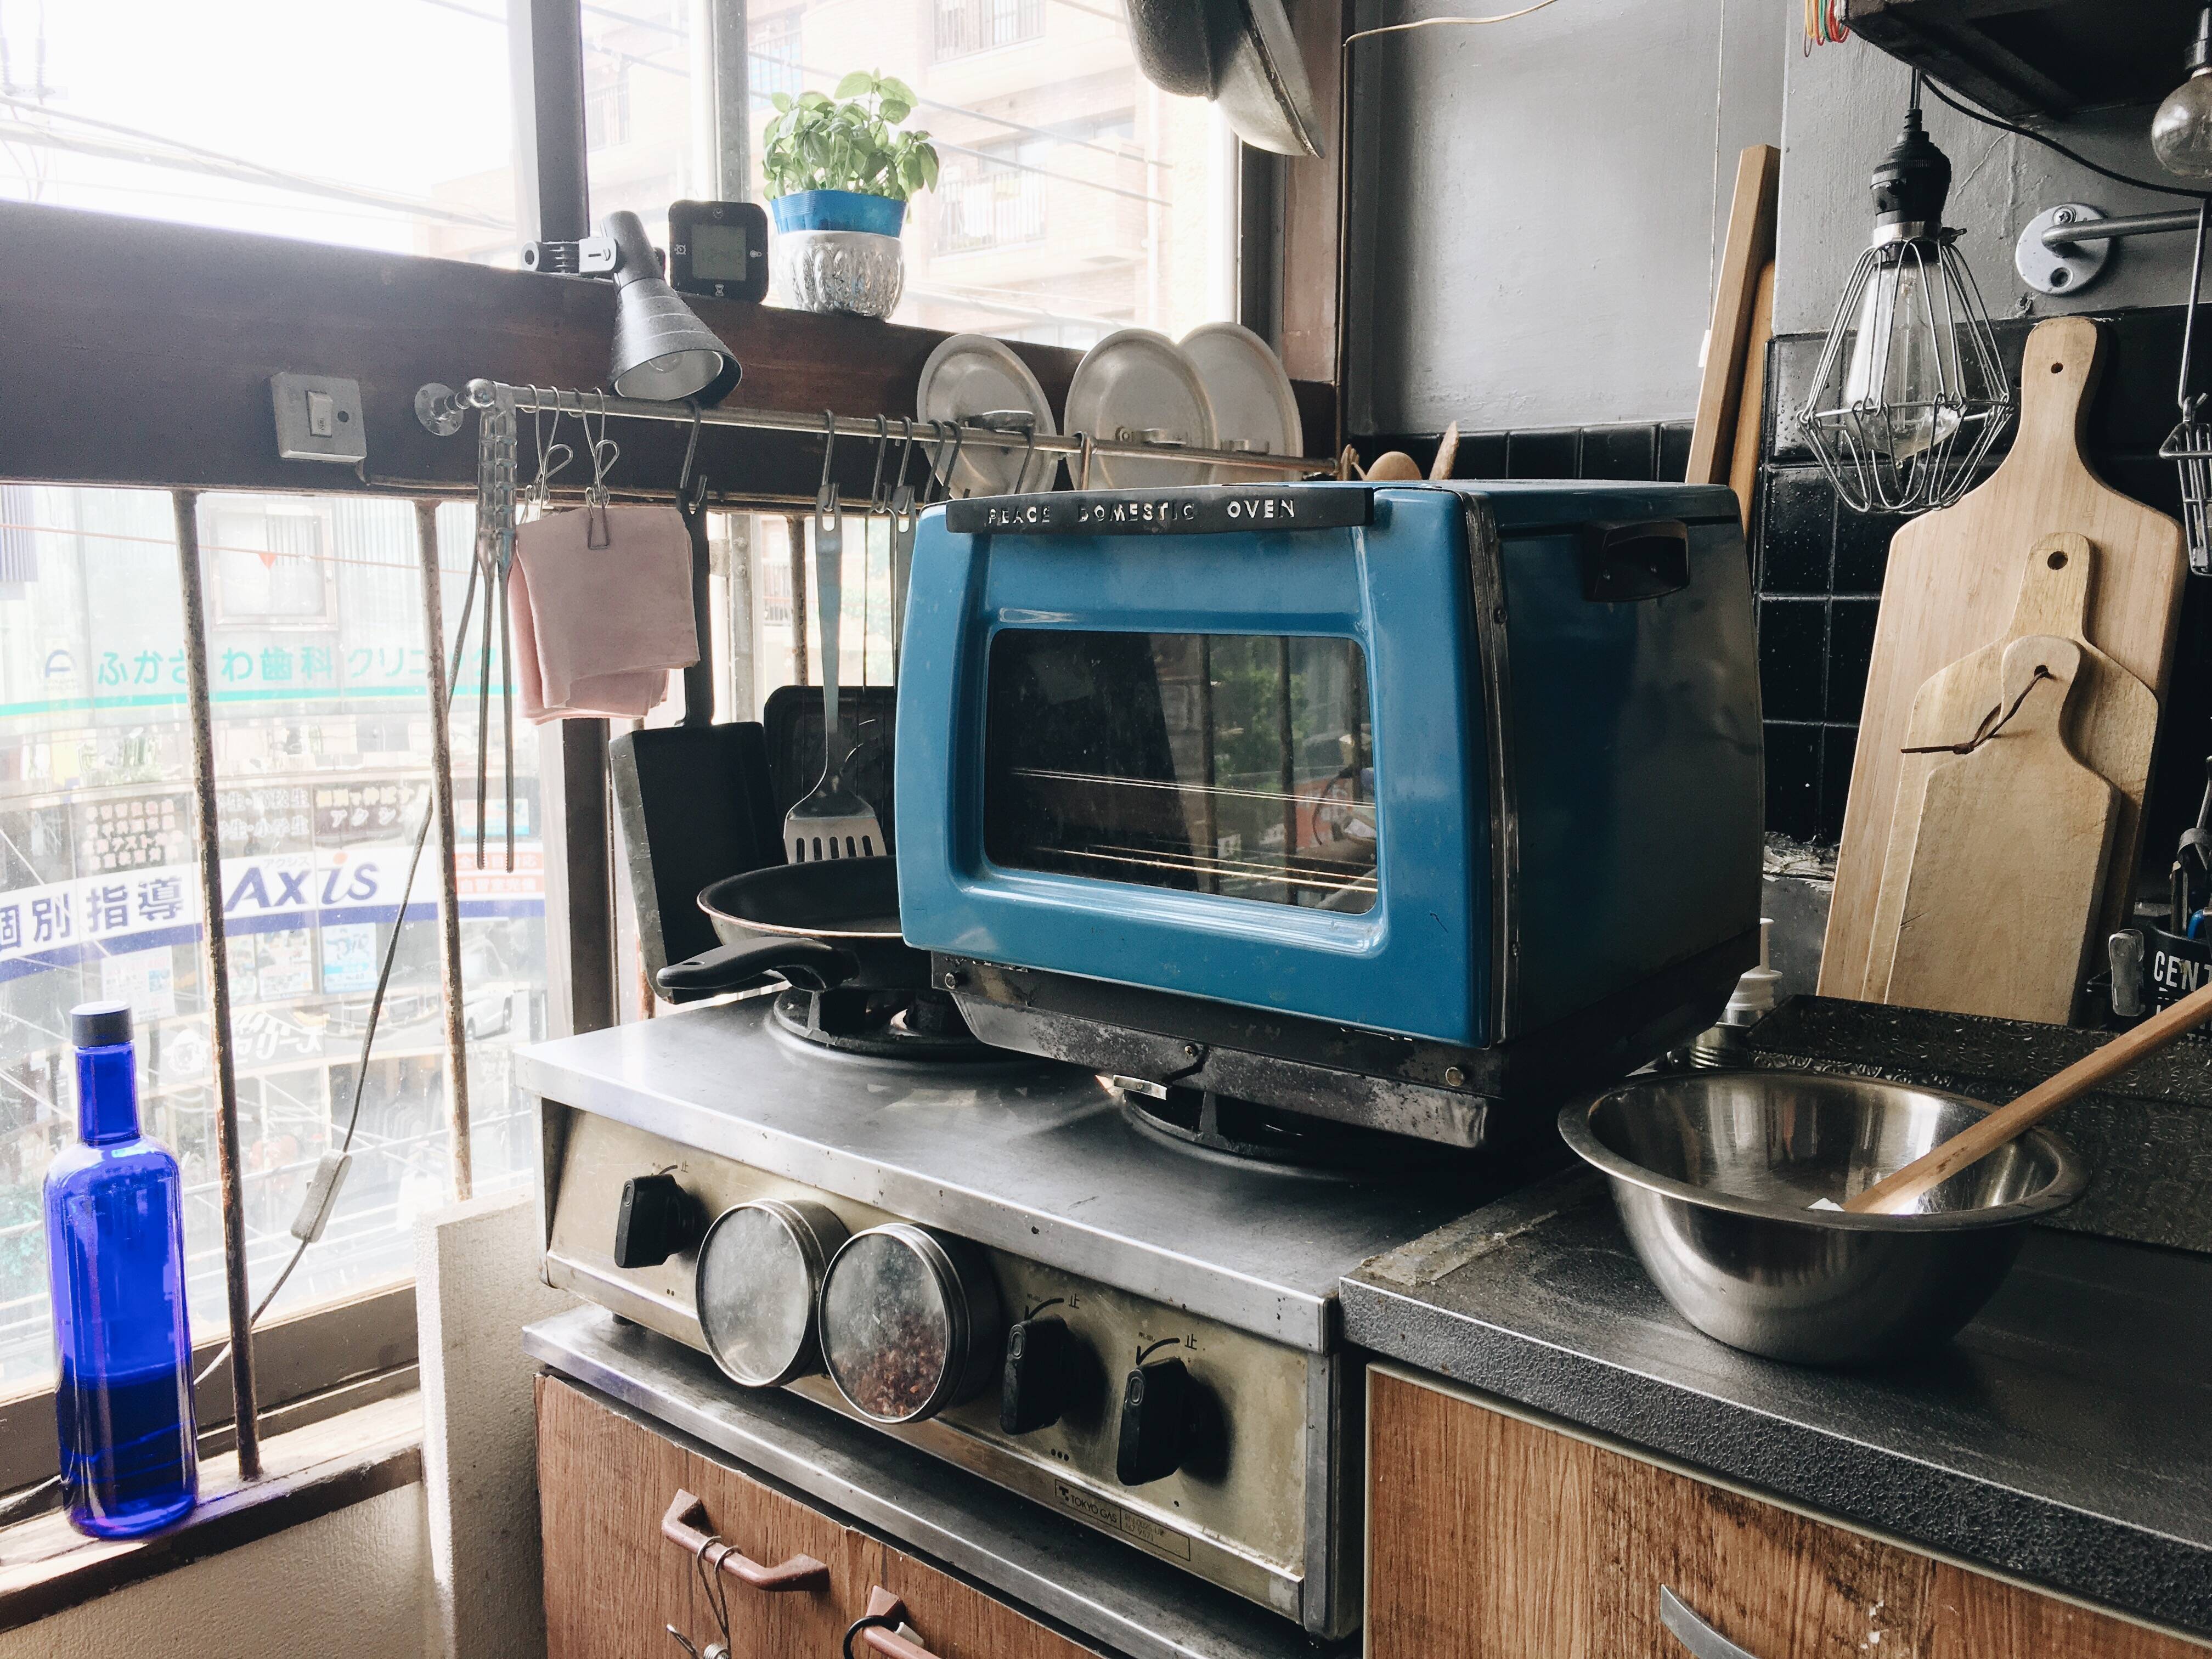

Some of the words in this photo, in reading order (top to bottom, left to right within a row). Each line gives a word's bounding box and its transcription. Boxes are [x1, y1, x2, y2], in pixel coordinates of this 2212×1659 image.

[988, 506, 1050, 524] PEACE
[1078, 501, 1194, 522] DOMESTIC
[1227, 498, 1295, 519] OVEN
[224, 851, 379, 911] Axis
[1069, 1294, 1080, 1309] 止
[1185, 1334, 1197, 1350] 止
[1071, 1495, 1099, 1515] TOKYO
[1100, 1509, 1117, 1523] GAS
